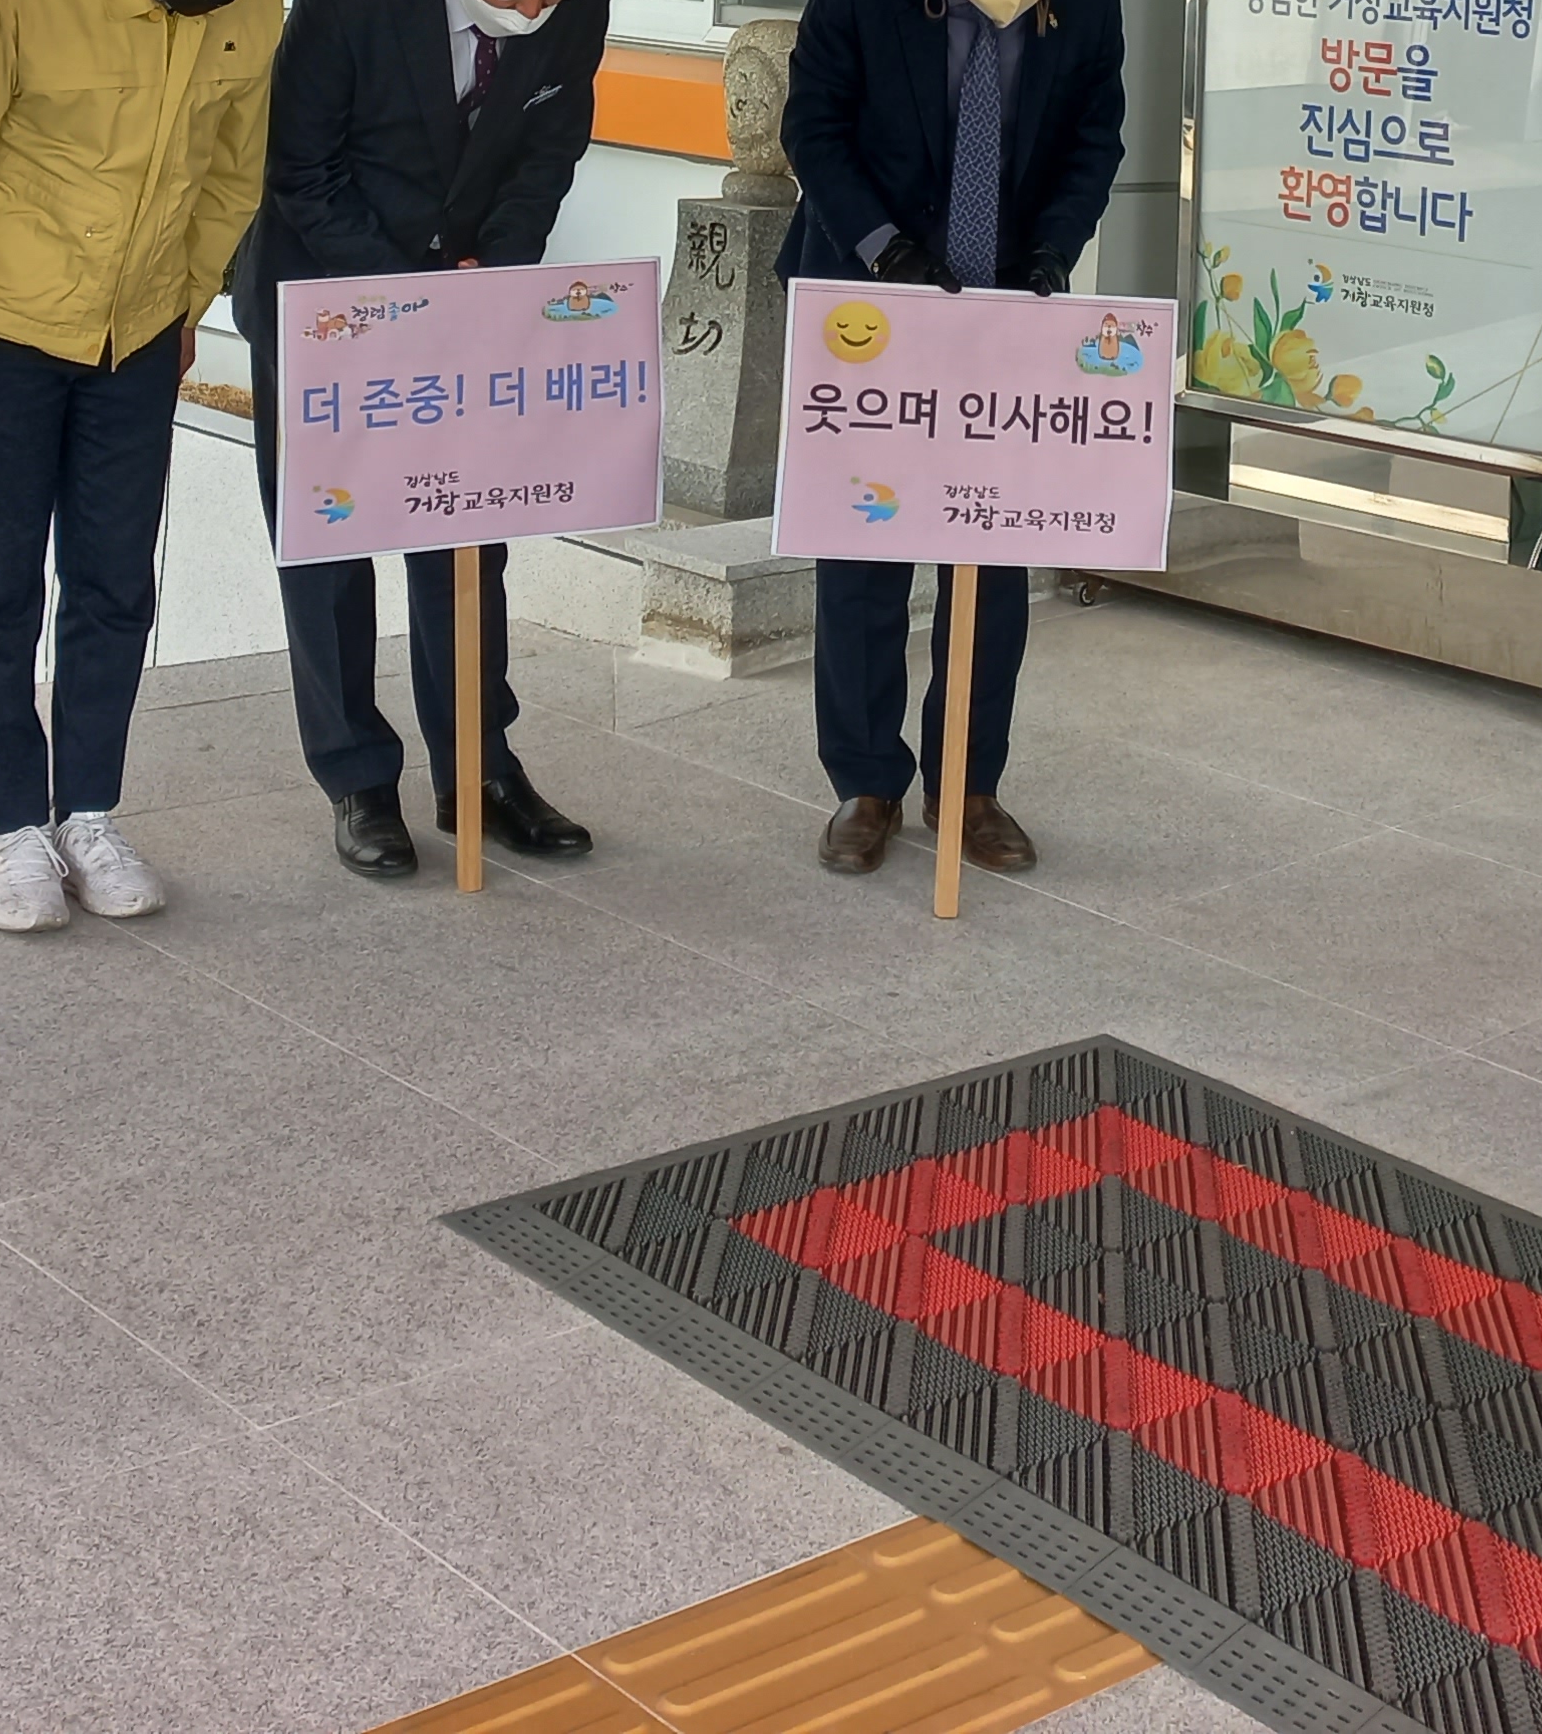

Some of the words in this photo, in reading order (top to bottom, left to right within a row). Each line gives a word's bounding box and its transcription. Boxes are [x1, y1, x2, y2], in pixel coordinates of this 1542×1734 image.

[1320, 36, 1440, 102] 방문을
[1299, 101, 1456, 167] 진심으로
[1276, 164, 1474, 243] 환영합니다
[1340, 286, 1435, 319] 거창교육지원청
[301, 381, 342, 434] 더
[358, 373, 466, 430] 존중!
[488, 366, 526, 417] 더
[545, 359, 648, 412] 배려!
[801, 382, 939, 440] 웃으며
[958, 391, 1154, 446] 인사해요!
[403, 470, 461, 489] 경상남도
[404, 481, 576, 517] 거창교육지원청
[942, 484, 1001, 500] 경상남도
[942, 501, 1117, 535] 거창교육지원청
